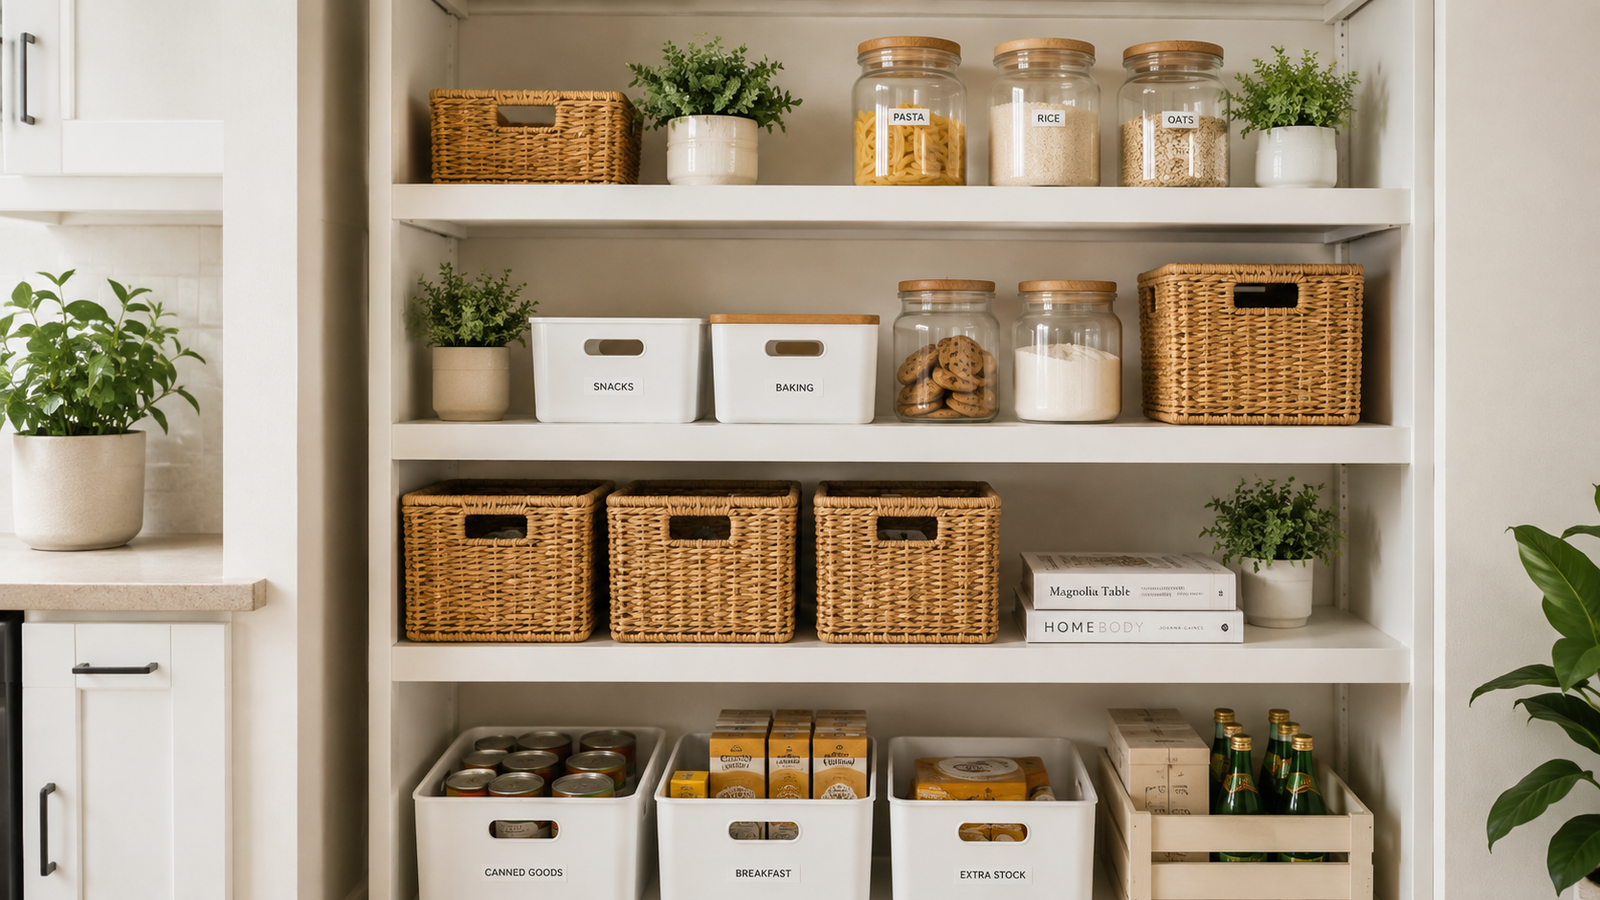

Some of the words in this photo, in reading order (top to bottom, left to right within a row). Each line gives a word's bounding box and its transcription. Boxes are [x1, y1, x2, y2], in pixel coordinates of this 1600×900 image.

[893, 112, 925, 122] PASTA
[1037, 113, 1061, 123] RICE
[1167, 115, 1195, 125] OATS
[593, 381, 635, 392] SNACKS
[775, 382, 815, 393] BAKING
[1049, 585, 1099, 599] Magnolia
[1101, 585, 1131, 597] Table
[484, 867, 525, 877] CANNED
[528, 867, 564, 877] GOODS
[735, 868, 792, 878] BREAKFAST
[959, 870, 991, 880] EXTRA
[993, 870, 1026, 880] STOCK
